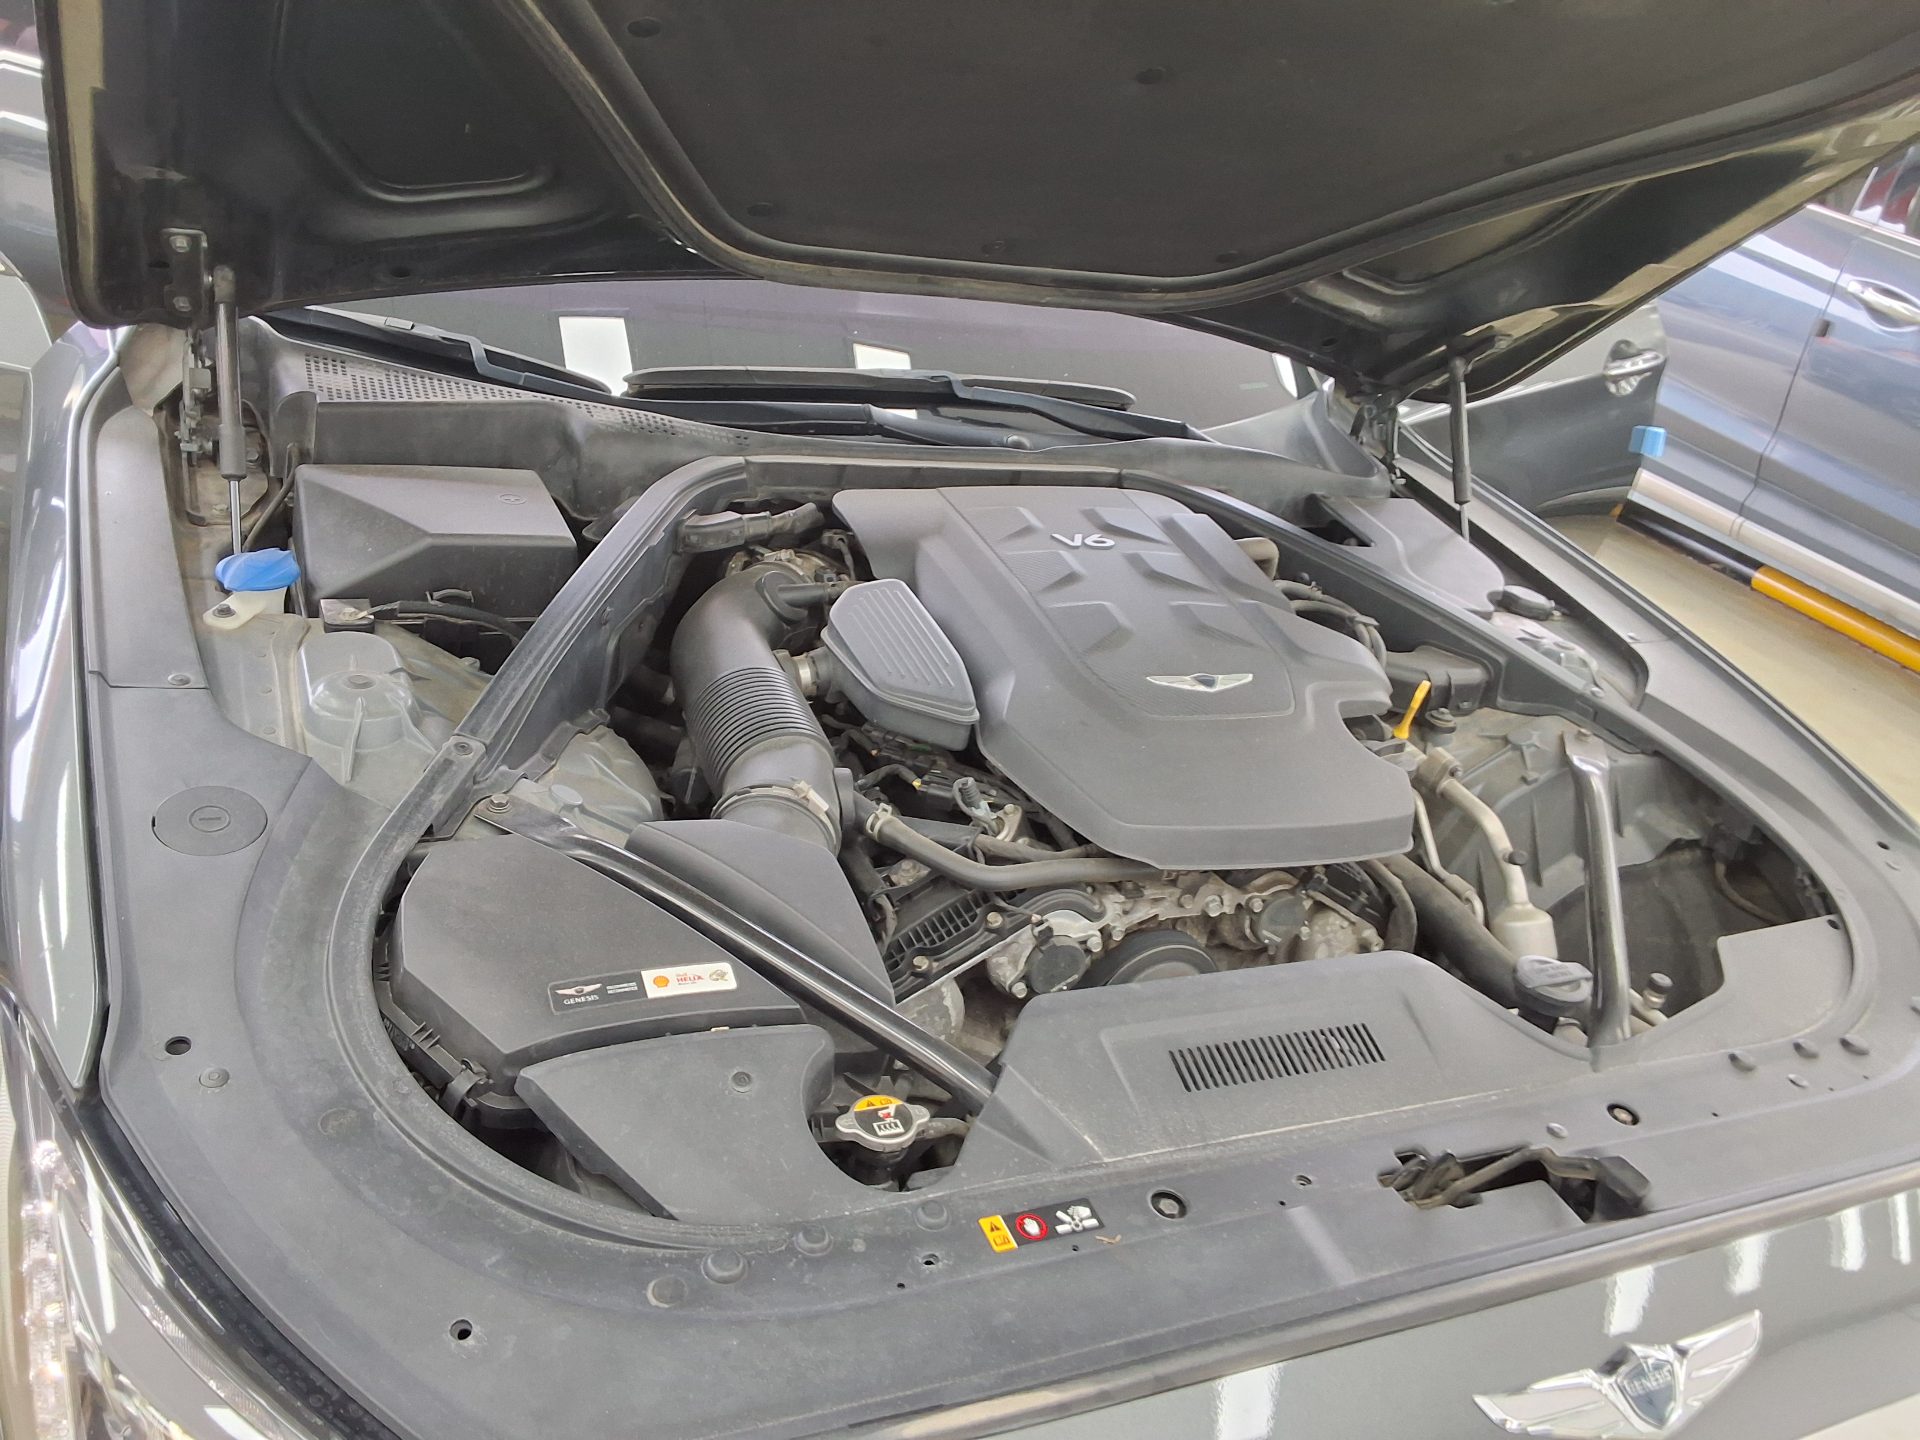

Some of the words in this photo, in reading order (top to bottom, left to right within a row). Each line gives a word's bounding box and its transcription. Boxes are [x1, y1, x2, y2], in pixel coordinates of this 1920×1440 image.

[1050, 533, 1116, 550] V6
[563, 993, 600, 1005] GENESIS
[1623, 1364, 1673, 1397] GENESIS
